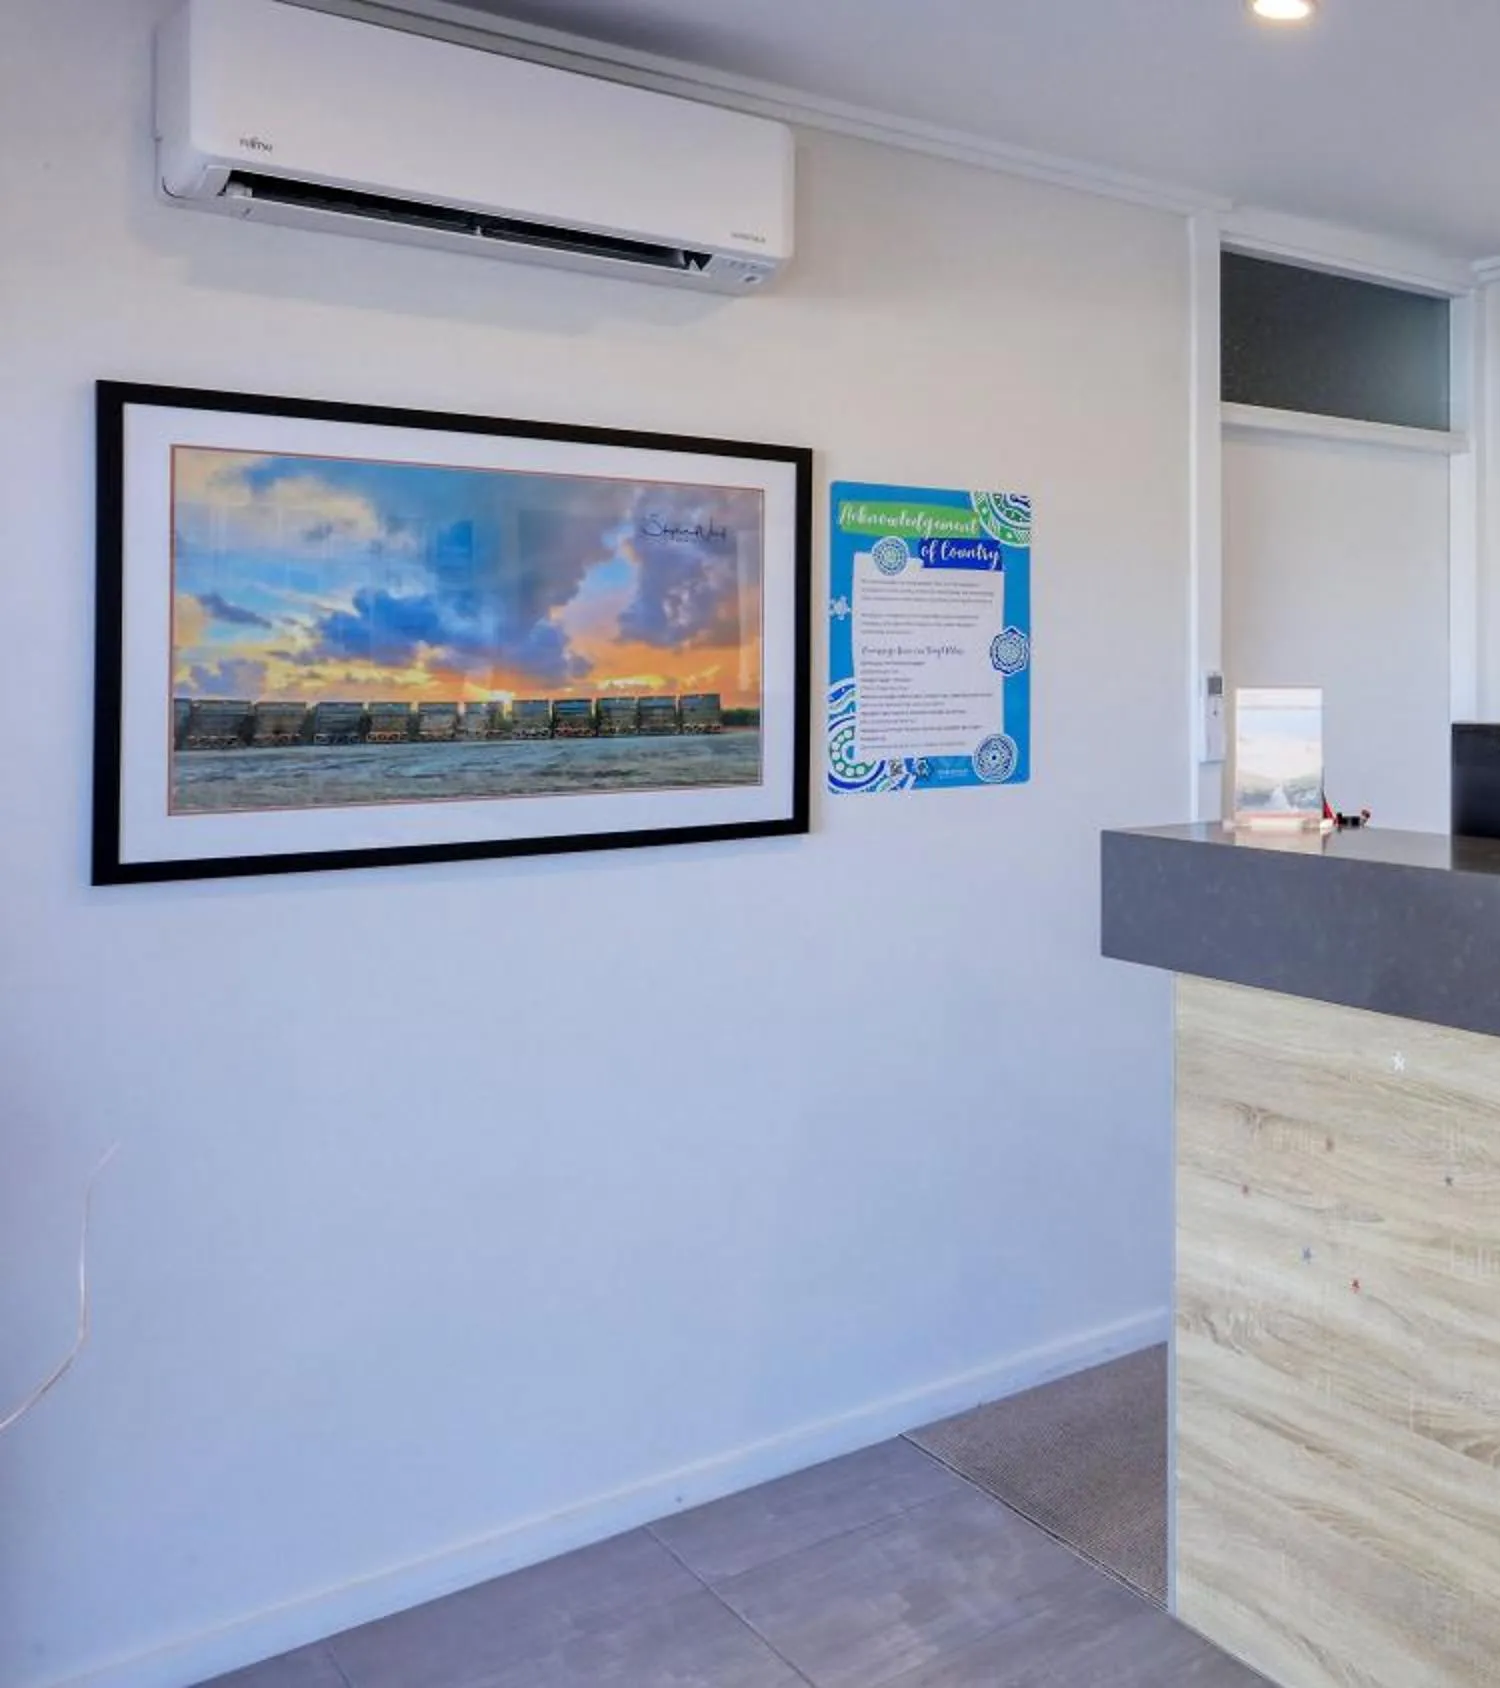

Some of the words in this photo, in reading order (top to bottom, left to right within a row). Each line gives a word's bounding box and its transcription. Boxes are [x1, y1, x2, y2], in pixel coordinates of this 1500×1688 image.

[839, 502, 979, 539] Acknowledgement
[920, 540, 936, 562] of
[940, 539, 1000, 570] Country
